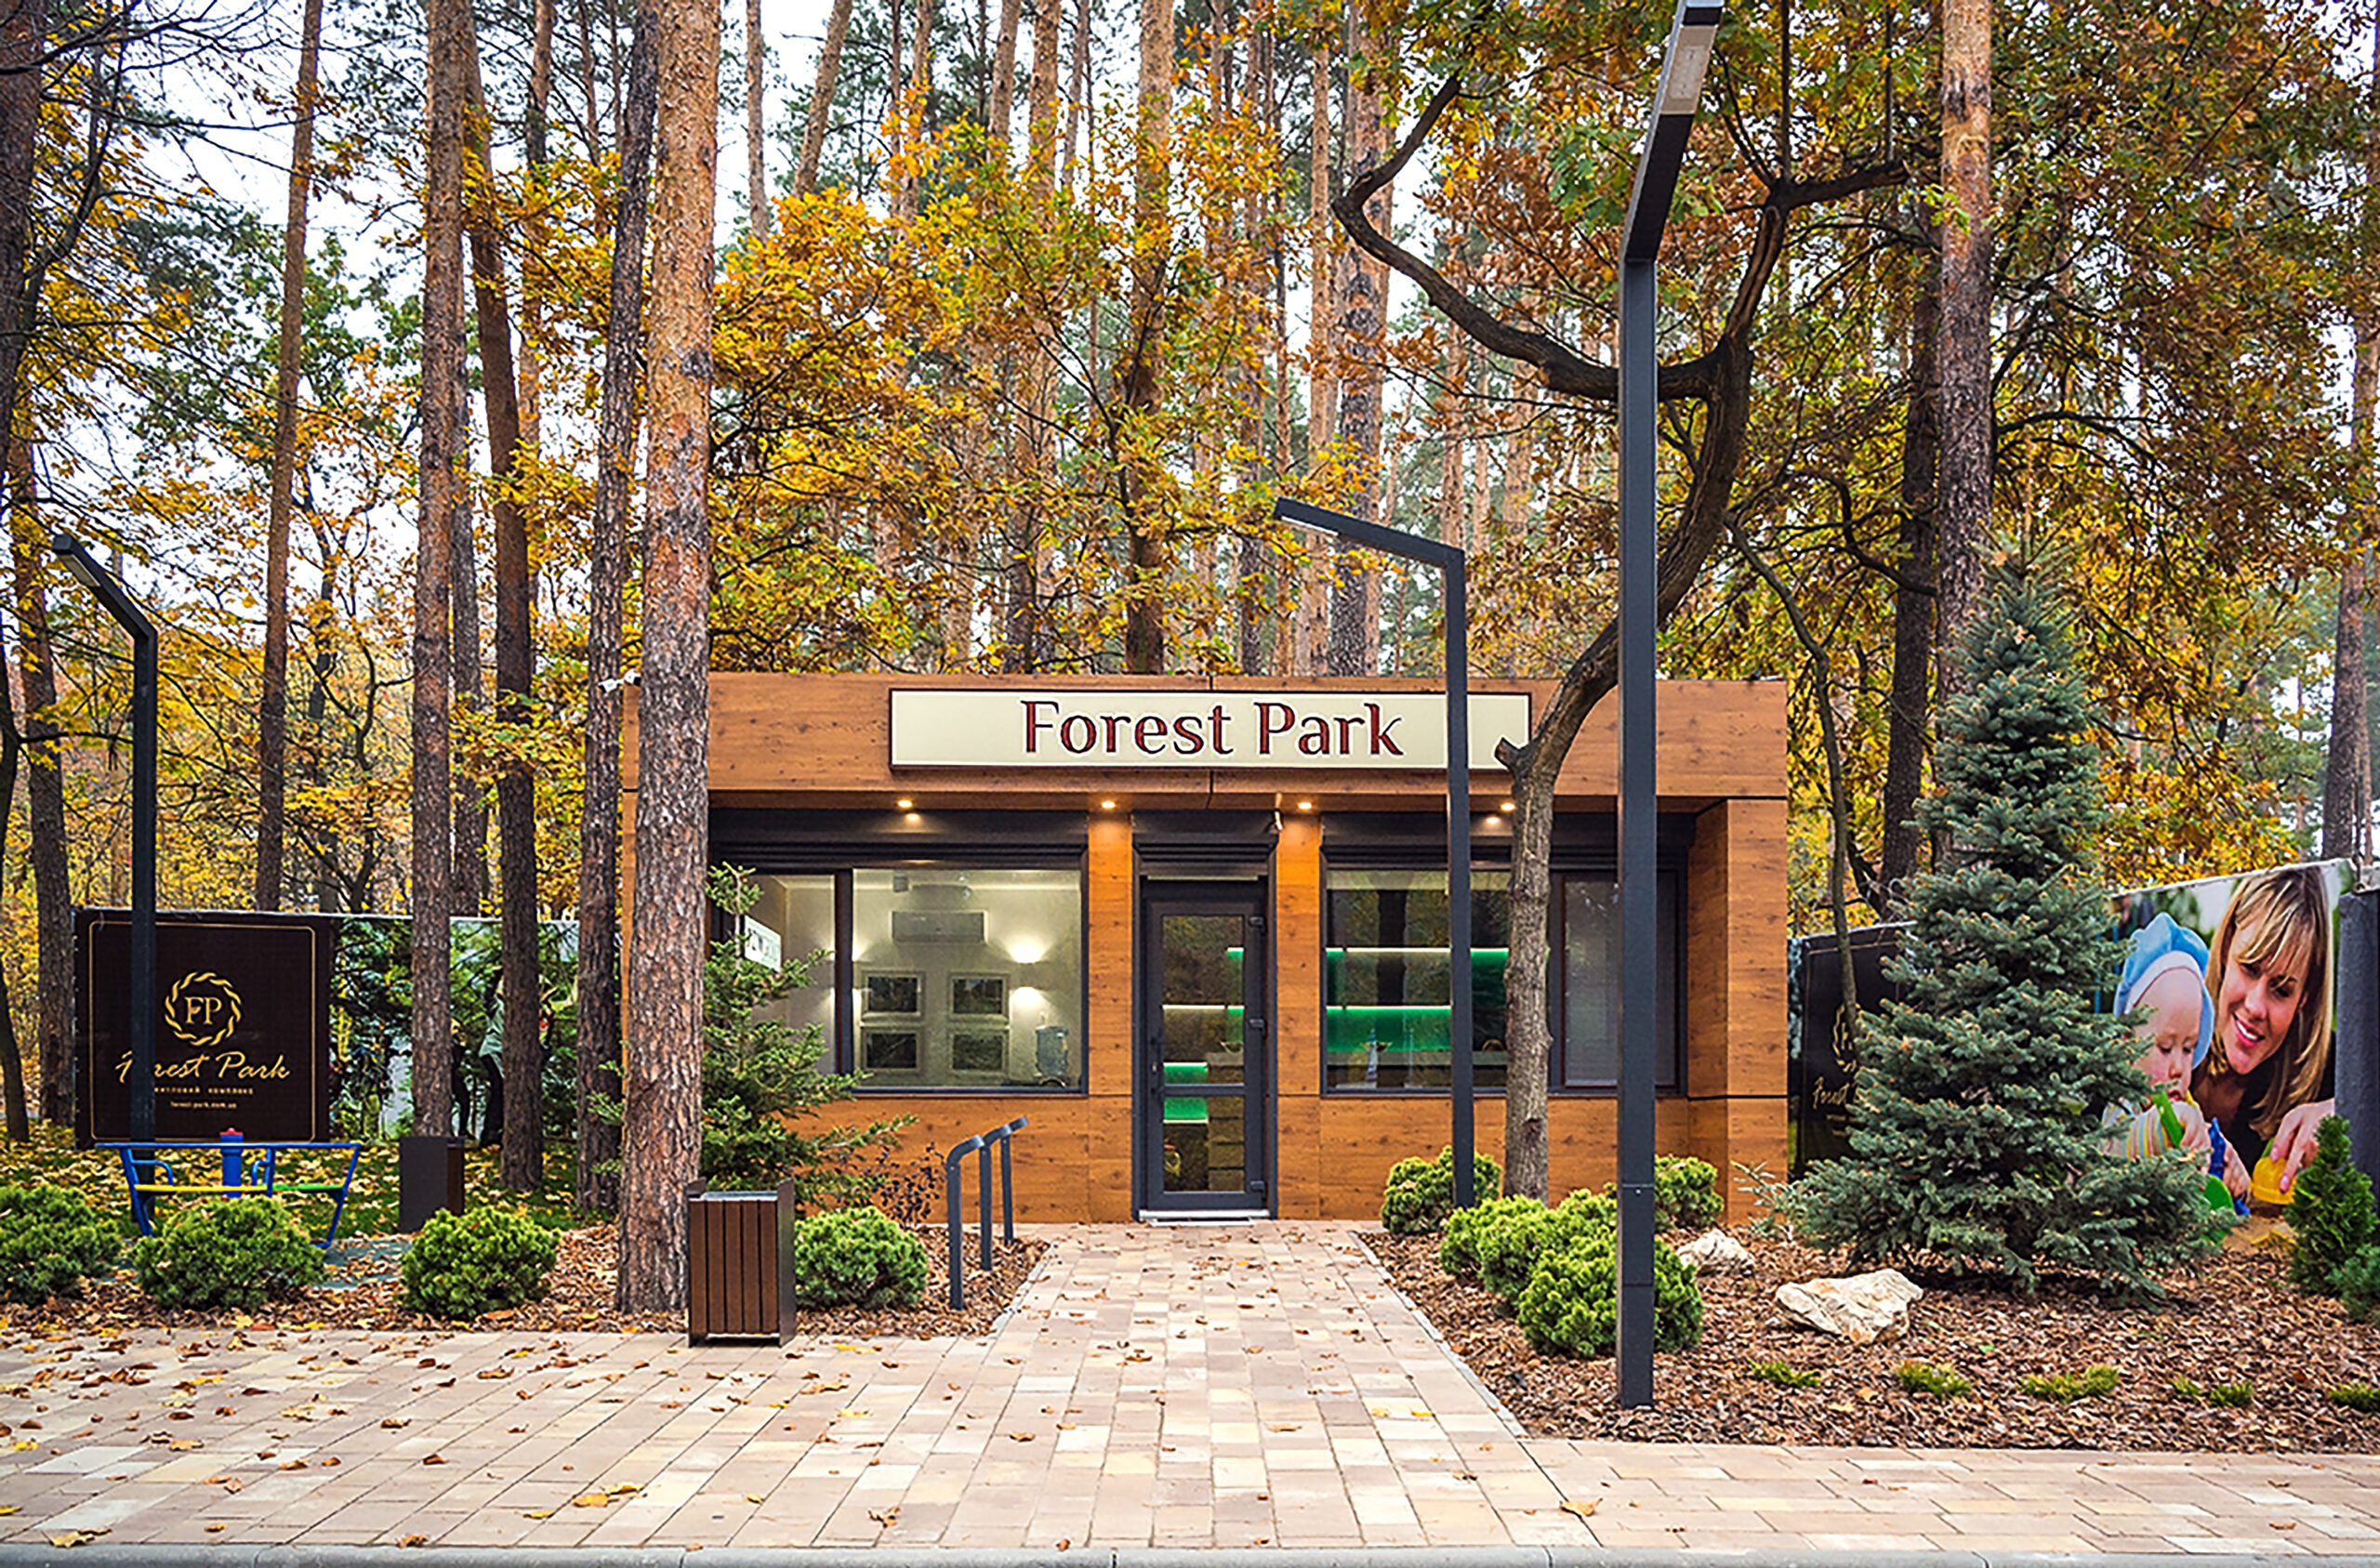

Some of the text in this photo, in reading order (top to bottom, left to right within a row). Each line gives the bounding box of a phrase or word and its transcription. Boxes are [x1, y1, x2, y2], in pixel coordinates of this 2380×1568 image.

[1020, 699, 1404, 756] Forest Park
[184, 996, 222, 1025] FP
[114, 1050, 291, 1084] Frest Park
